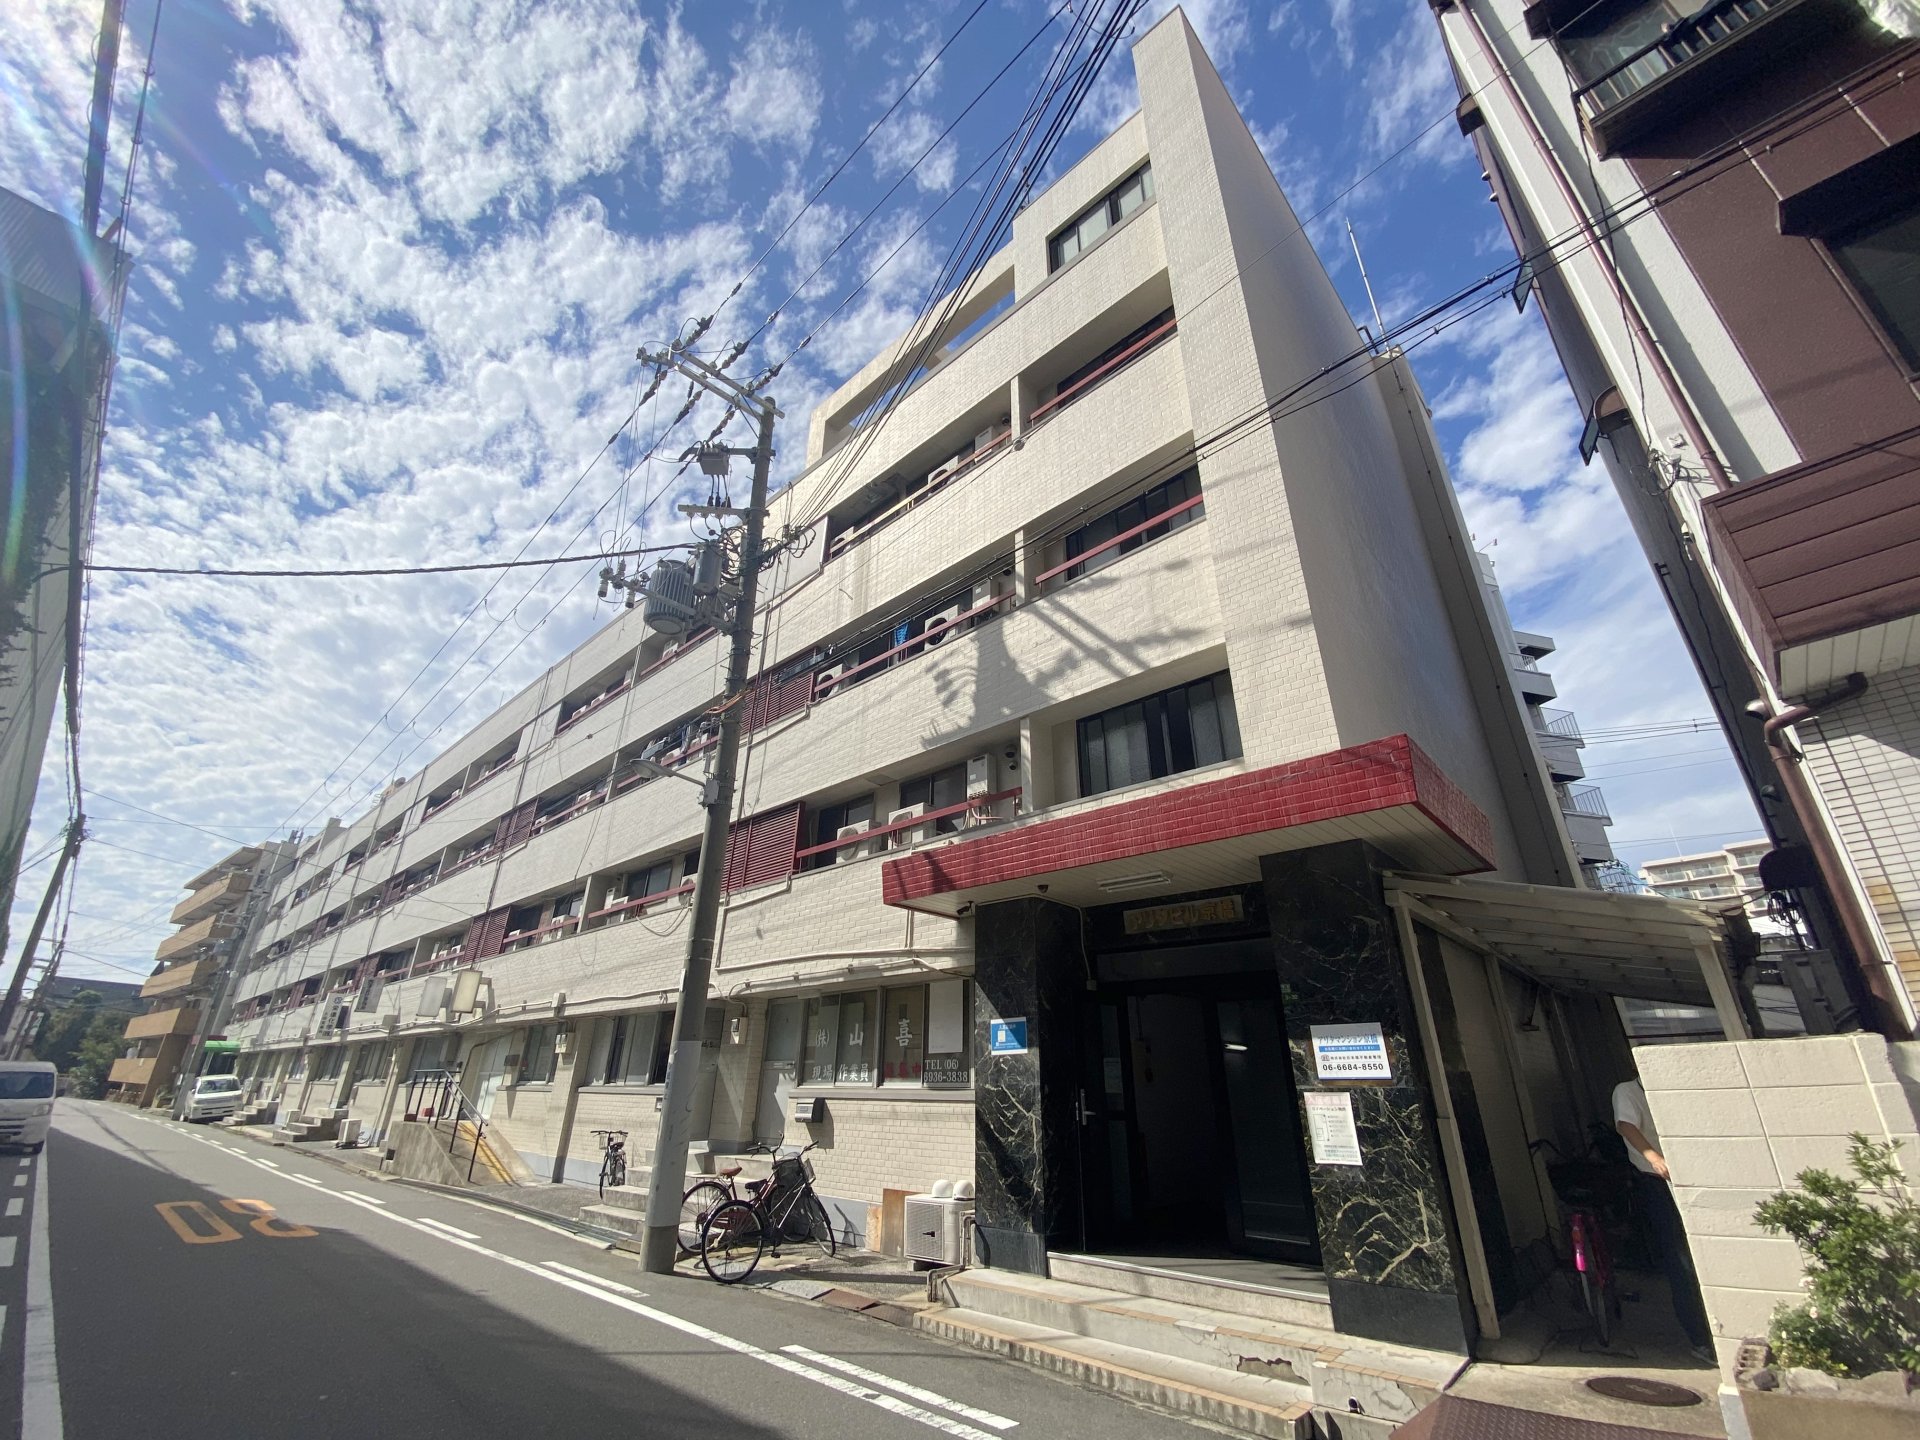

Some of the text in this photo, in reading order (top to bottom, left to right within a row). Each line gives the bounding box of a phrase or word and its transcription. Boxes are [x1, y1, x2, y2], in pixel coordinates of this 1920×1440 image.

[850, 1023, 864, 1046] 山
[895, 1018, 913, 1047] 喜
[925, 1060, 942, 1070] TEL
